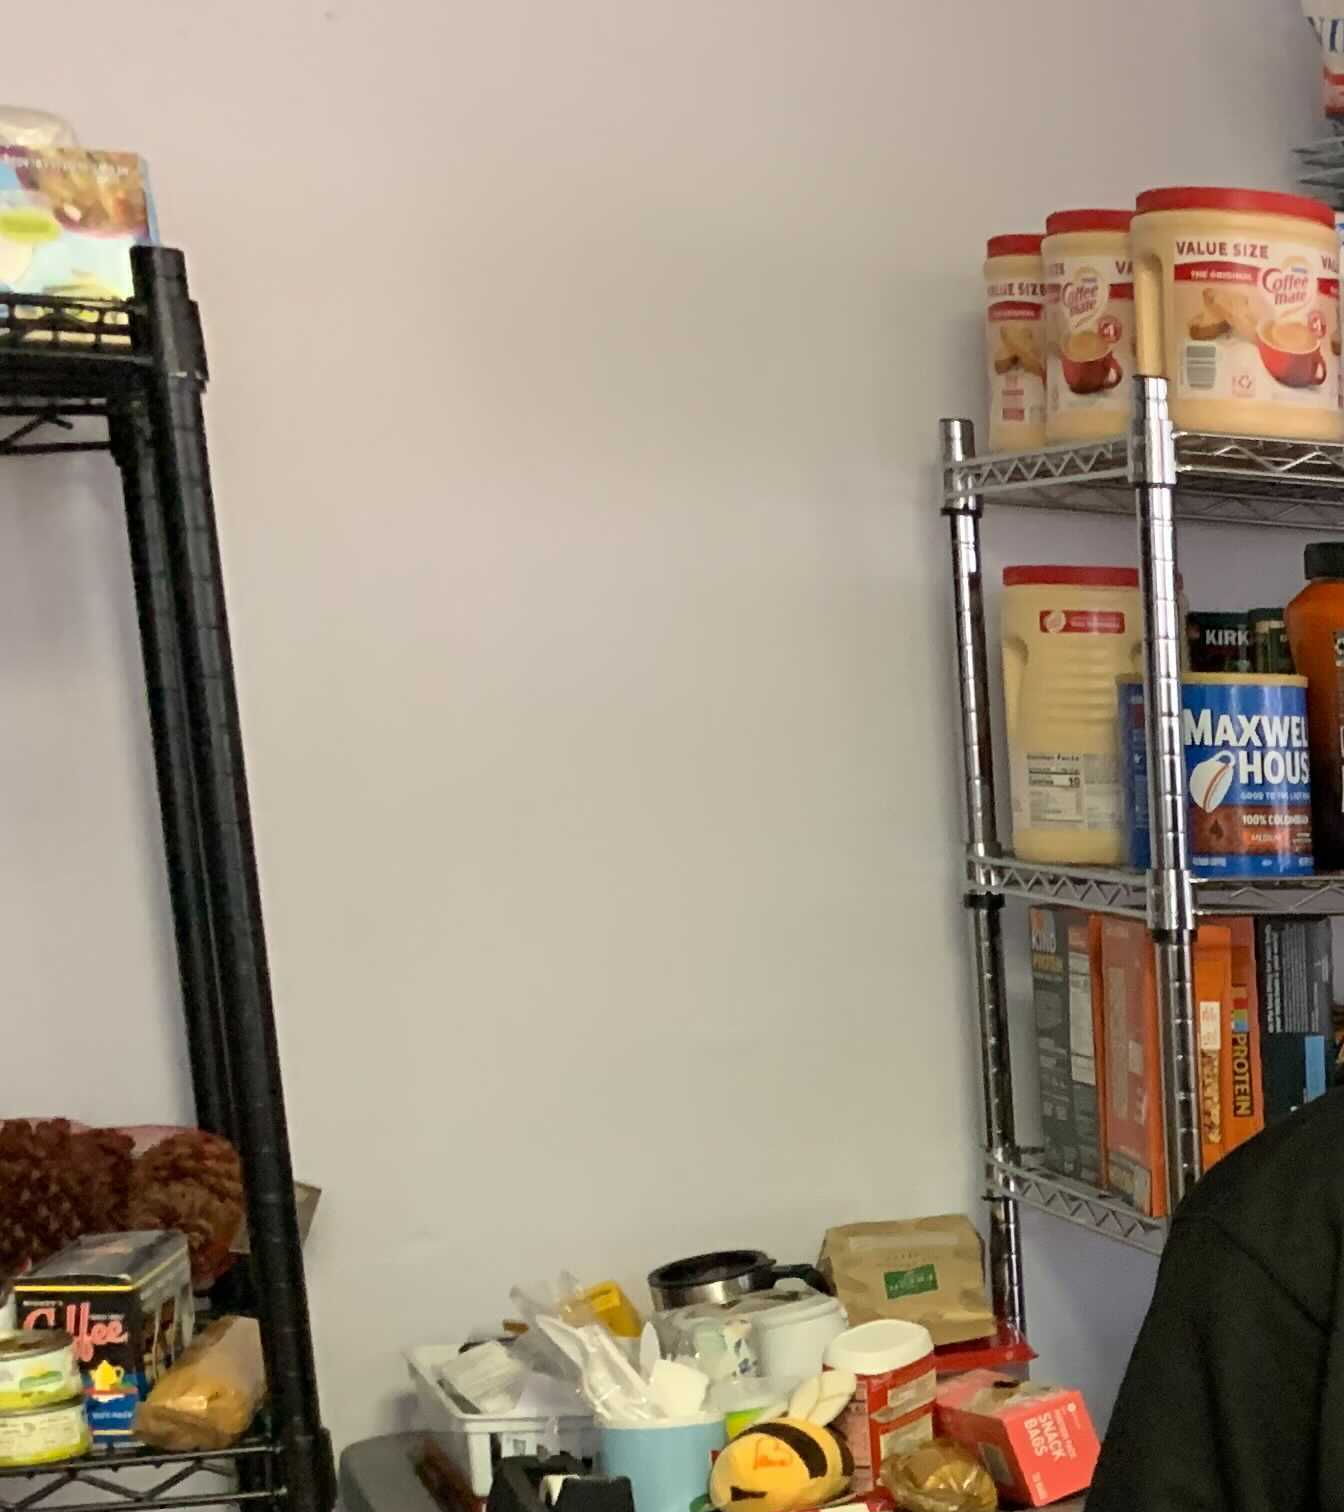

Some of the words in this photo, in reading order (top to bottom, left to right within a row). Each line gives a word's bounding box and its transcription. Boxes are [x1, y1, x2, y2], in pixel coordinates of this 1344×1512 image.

[1176, 241, 1227, 257] VALUE
[1233, 243, 1269, 259] SIZE
[1262, 267, 1309, 294] Coffee
[1232, 1033, 1252, 1116] PROTEIN
[1023, 1417, 1049, 1457] BAGS
[1038, 1410, 1067, 1462] SNACK
